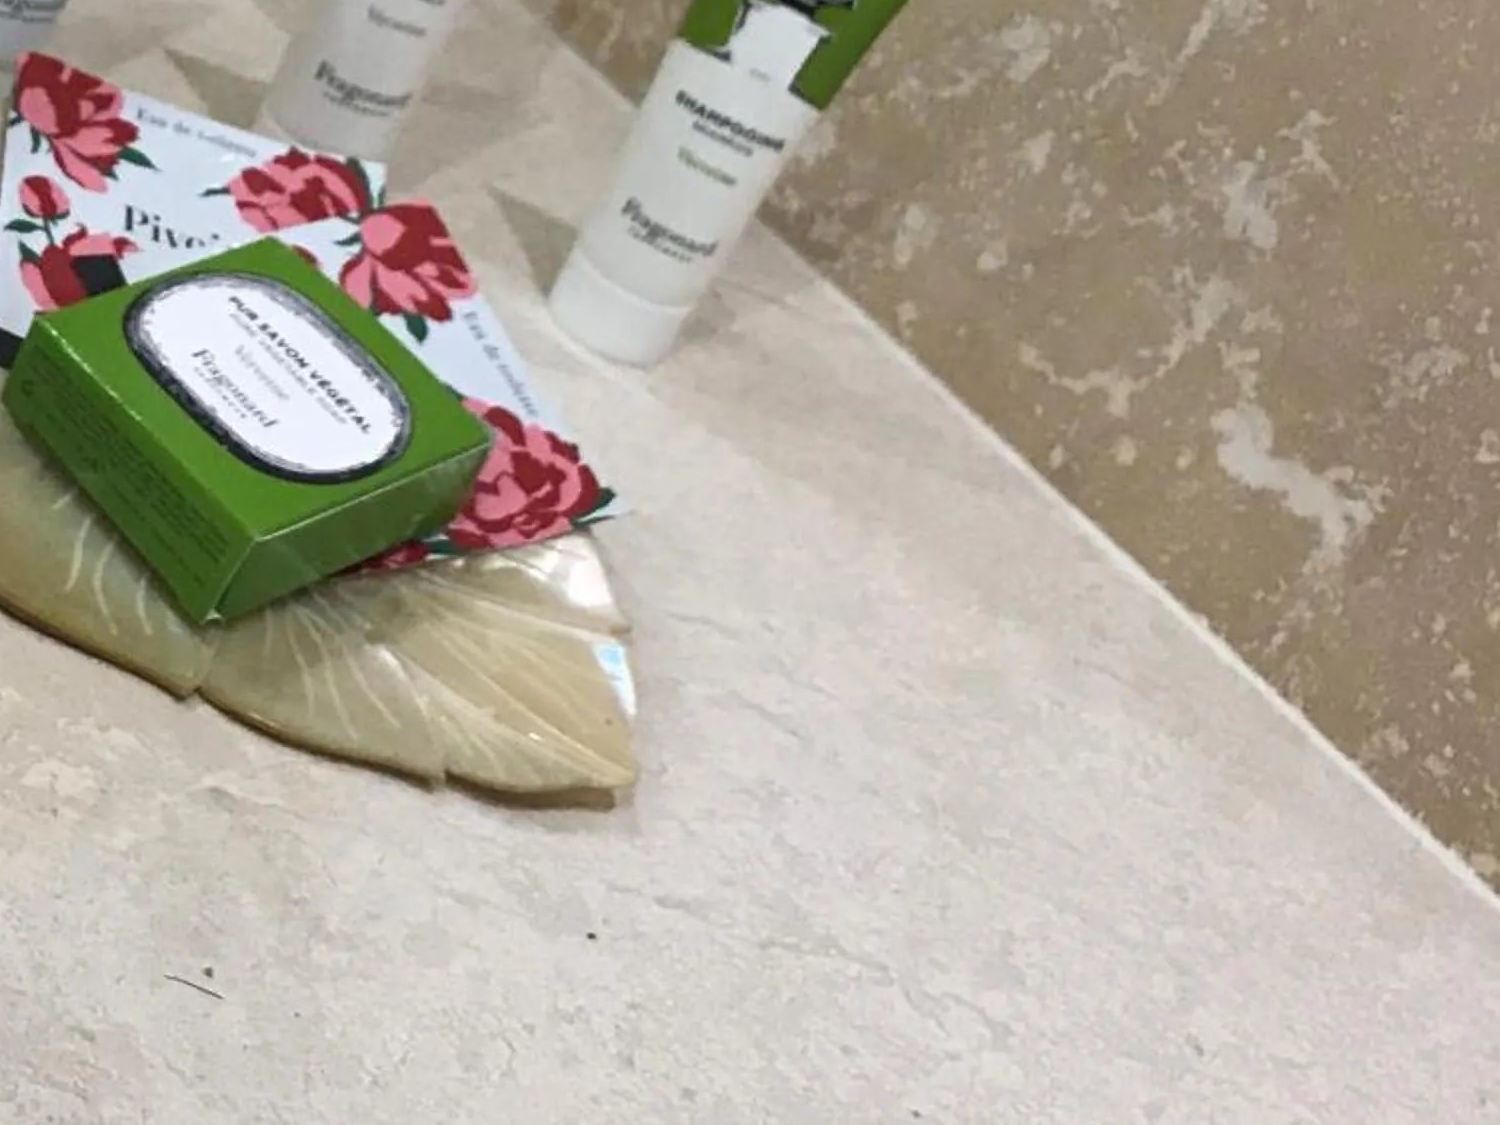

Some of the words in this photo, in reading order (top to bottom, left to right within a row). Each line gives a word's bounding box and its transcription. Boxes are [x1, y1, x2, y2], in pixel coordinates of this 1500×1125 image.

[228, 295, 259, 322] PUR
[258, 322, 310, 370] SAVON
[192, 347, 280, 428] Fragonard
